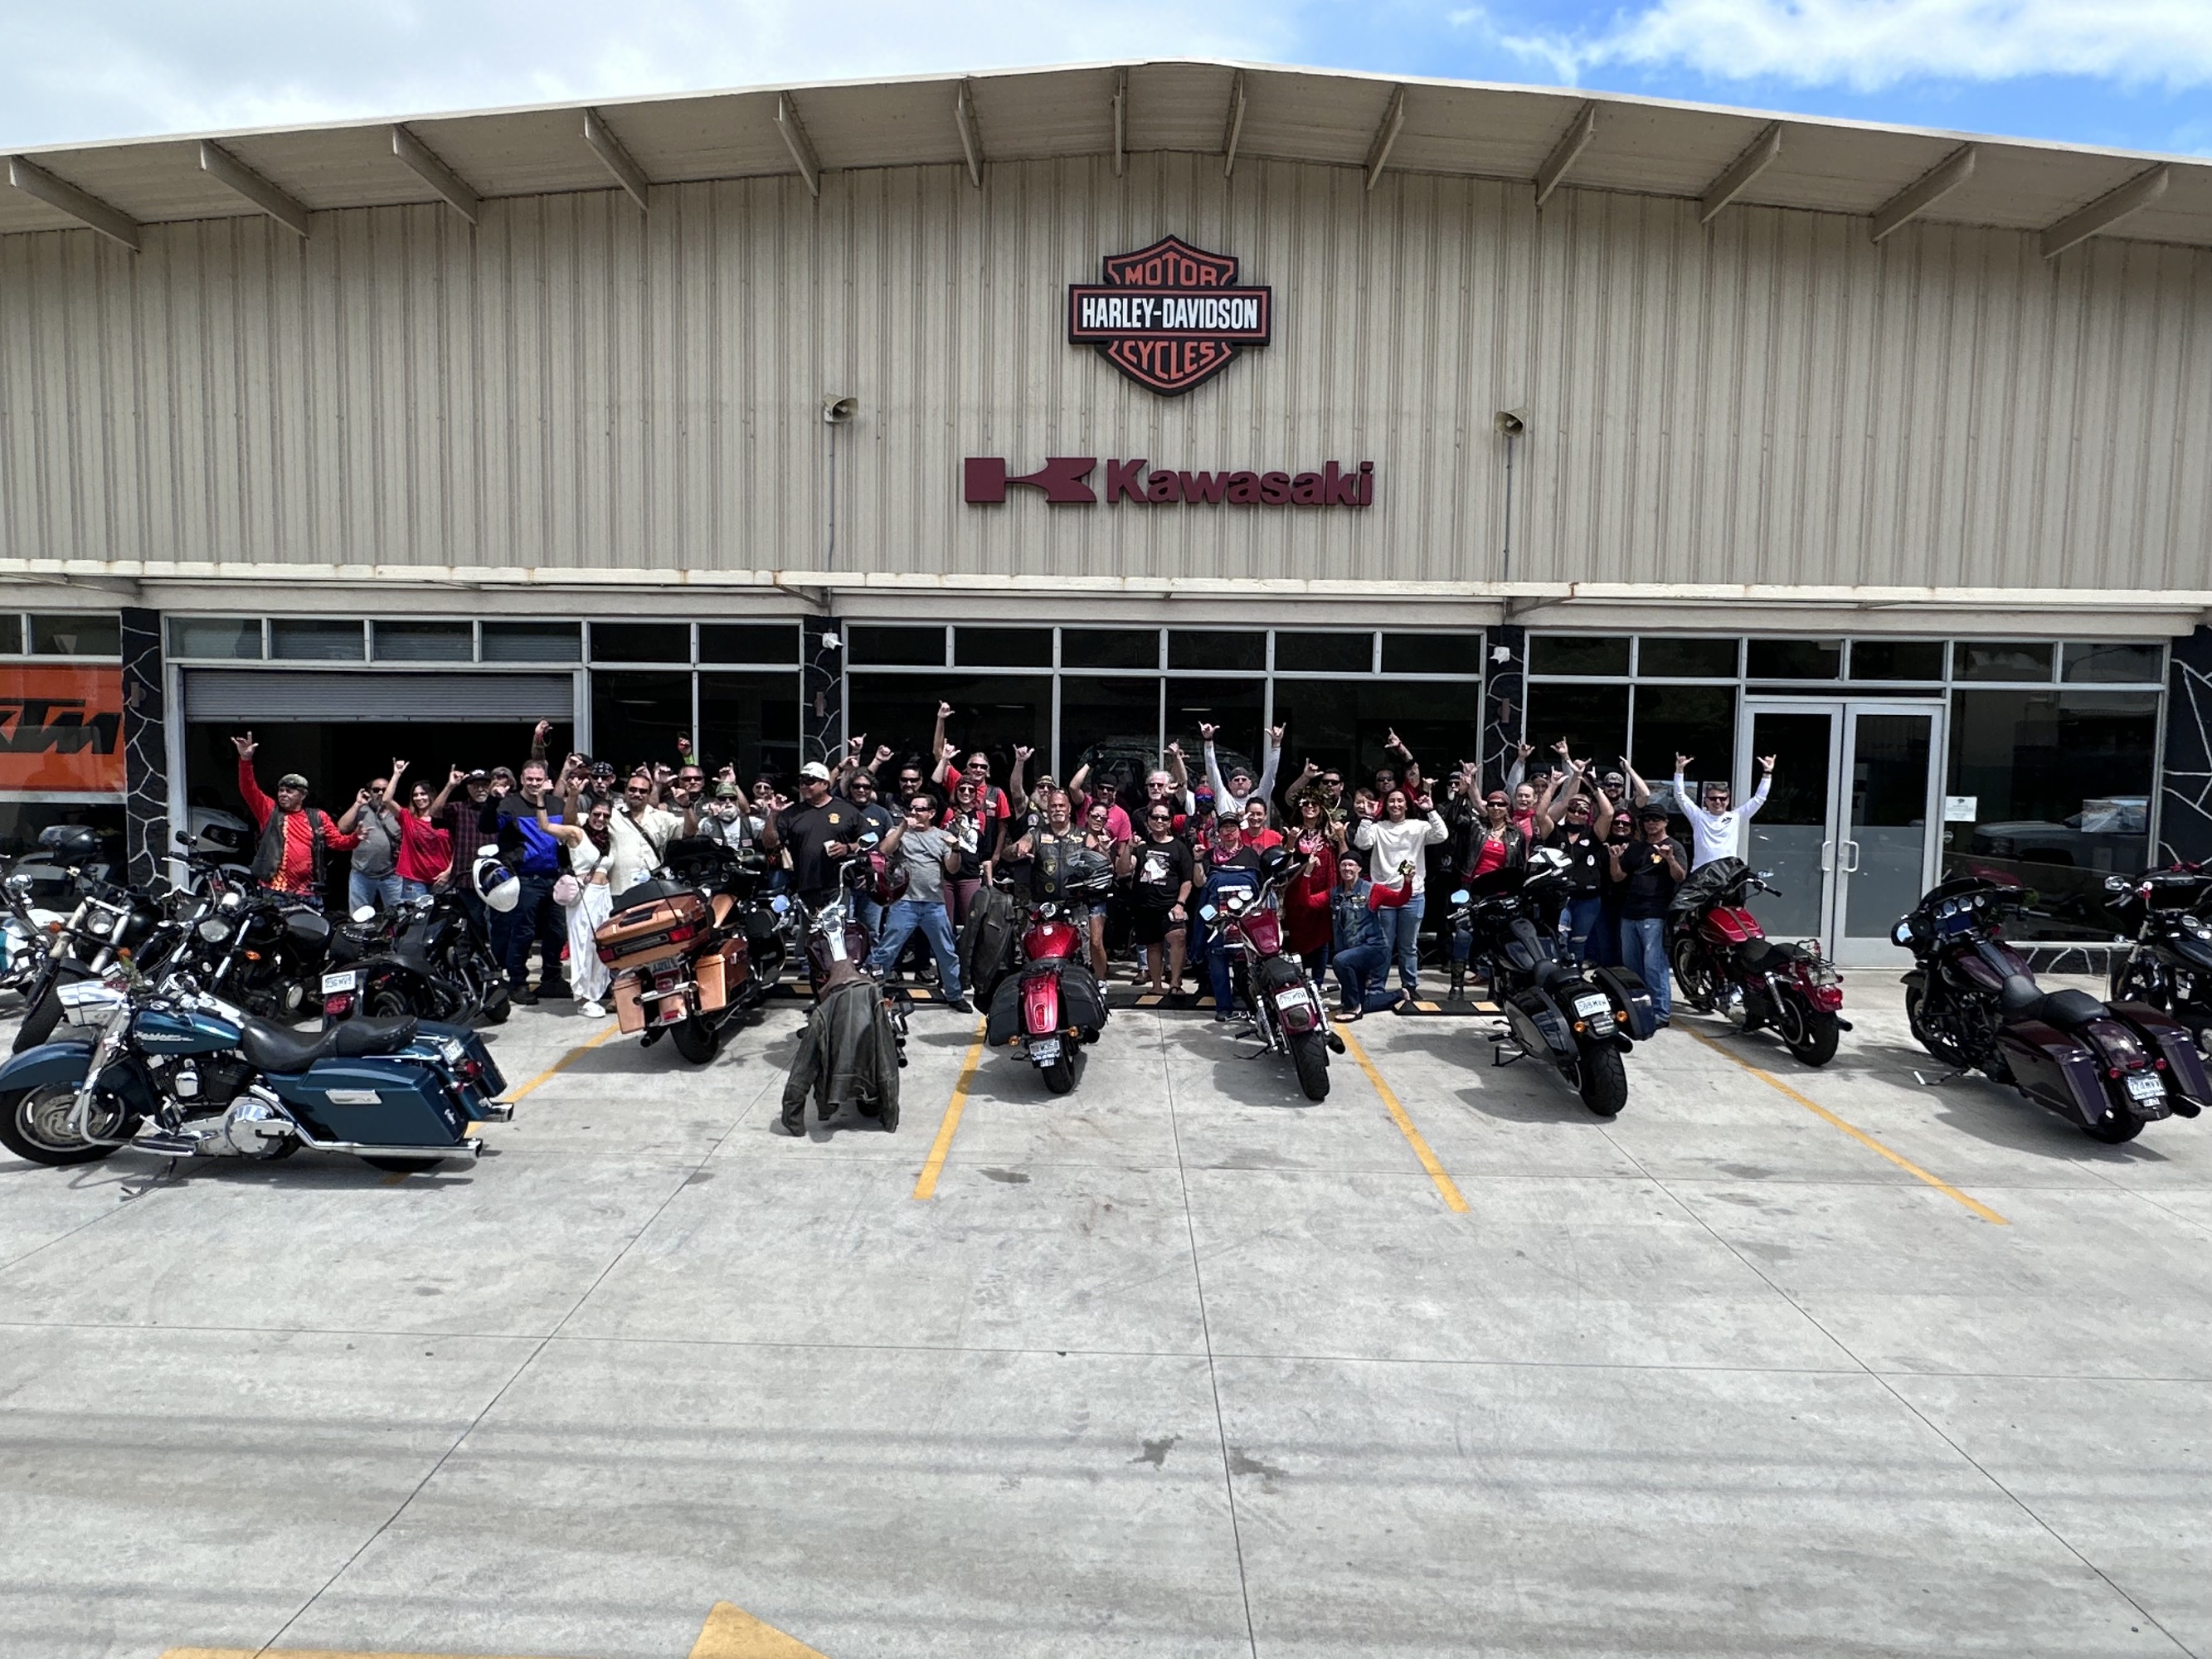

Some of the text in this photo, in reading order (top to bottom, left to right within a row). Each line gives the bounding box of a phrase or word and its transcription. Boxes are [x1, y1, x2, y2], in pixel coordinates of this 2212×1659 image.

[1125, 251, 1217, 286] MOTOR
[1082, 297, 1257, 329] HARLEY-DAVIDSON
[1122, 340, 1216, 380] CYCLES
[1106, 458, 1373, 507] Kawasaki
